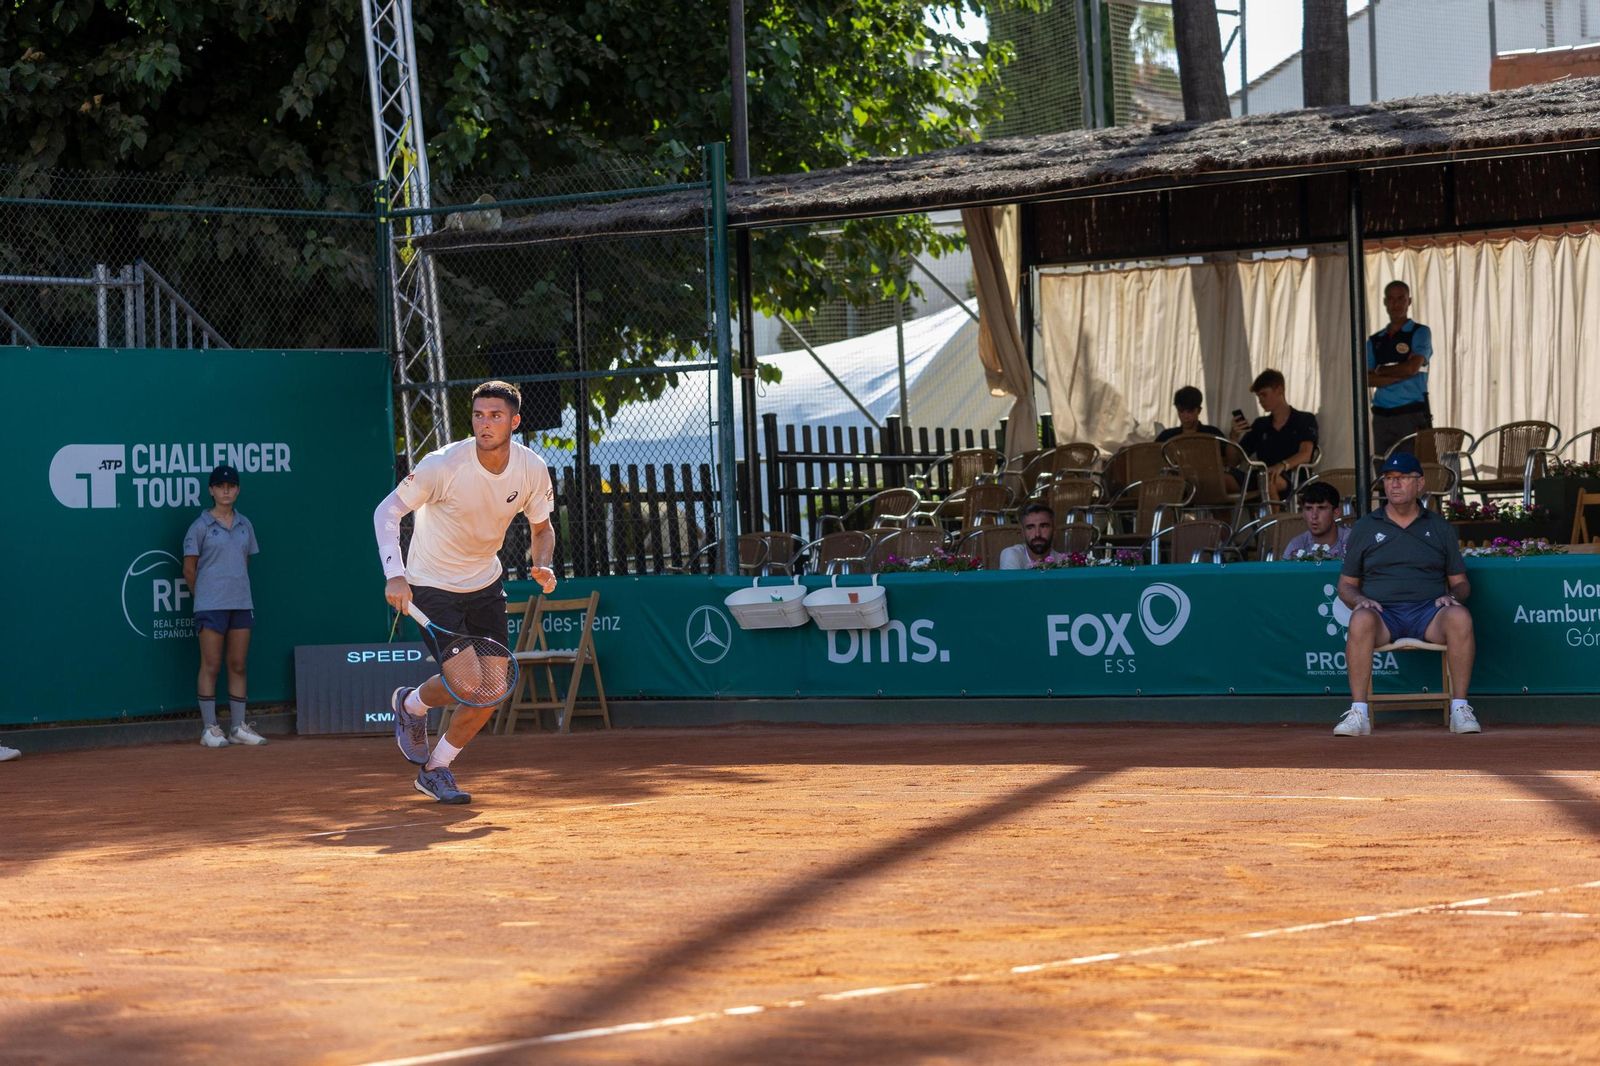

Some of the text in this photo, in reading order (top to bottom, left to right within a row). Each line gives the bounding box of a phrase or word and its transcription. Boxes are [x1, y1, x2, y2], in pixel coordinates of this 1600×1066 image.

[98, 460, 122, 470] ATP
[132, 442, 291, 474] CHALLENGER
[133, 477, 201, 508] TOUR
[153, 578, 192, 613] RF
[1513, 603, 1600, 623] Arambur
[154, 618, 195, 628] REAL FEDE
[154, 627, 194, 639] ESPAÑOLA
[1047, 613, 1135, 656] FOX
[347, 649, 422, 663] SPEED
[1306, 651, 1399, 670] PROSA
[1104, 659, 1136, 673] ESS
[365, 713, 396, 722] KM/
